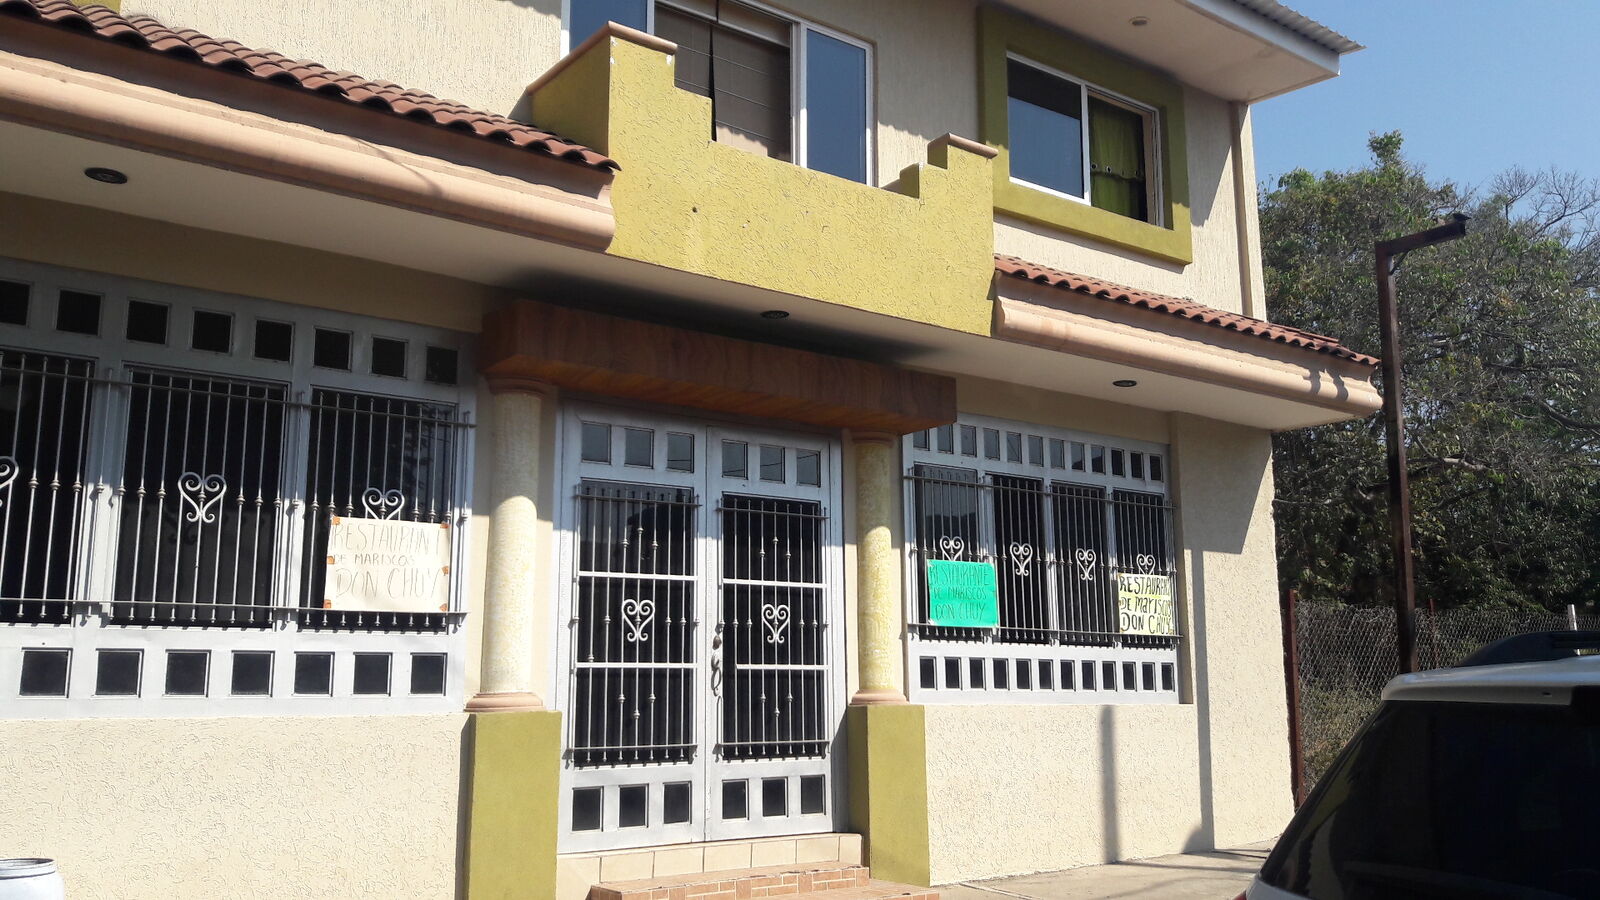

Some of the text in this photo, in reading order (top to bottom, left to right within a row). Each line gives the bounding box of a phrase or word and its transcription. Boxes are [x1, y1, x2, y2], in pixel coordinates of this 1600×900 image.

[336, 567, 440, 599] DON CHUY
[948, 587, 987, 600] MARISCOS
[935, 602, 986, 621] DON CHUY
[1120, 597, 1132, 611] DE
[1120, 612, 1172, 634] DON CHUY
